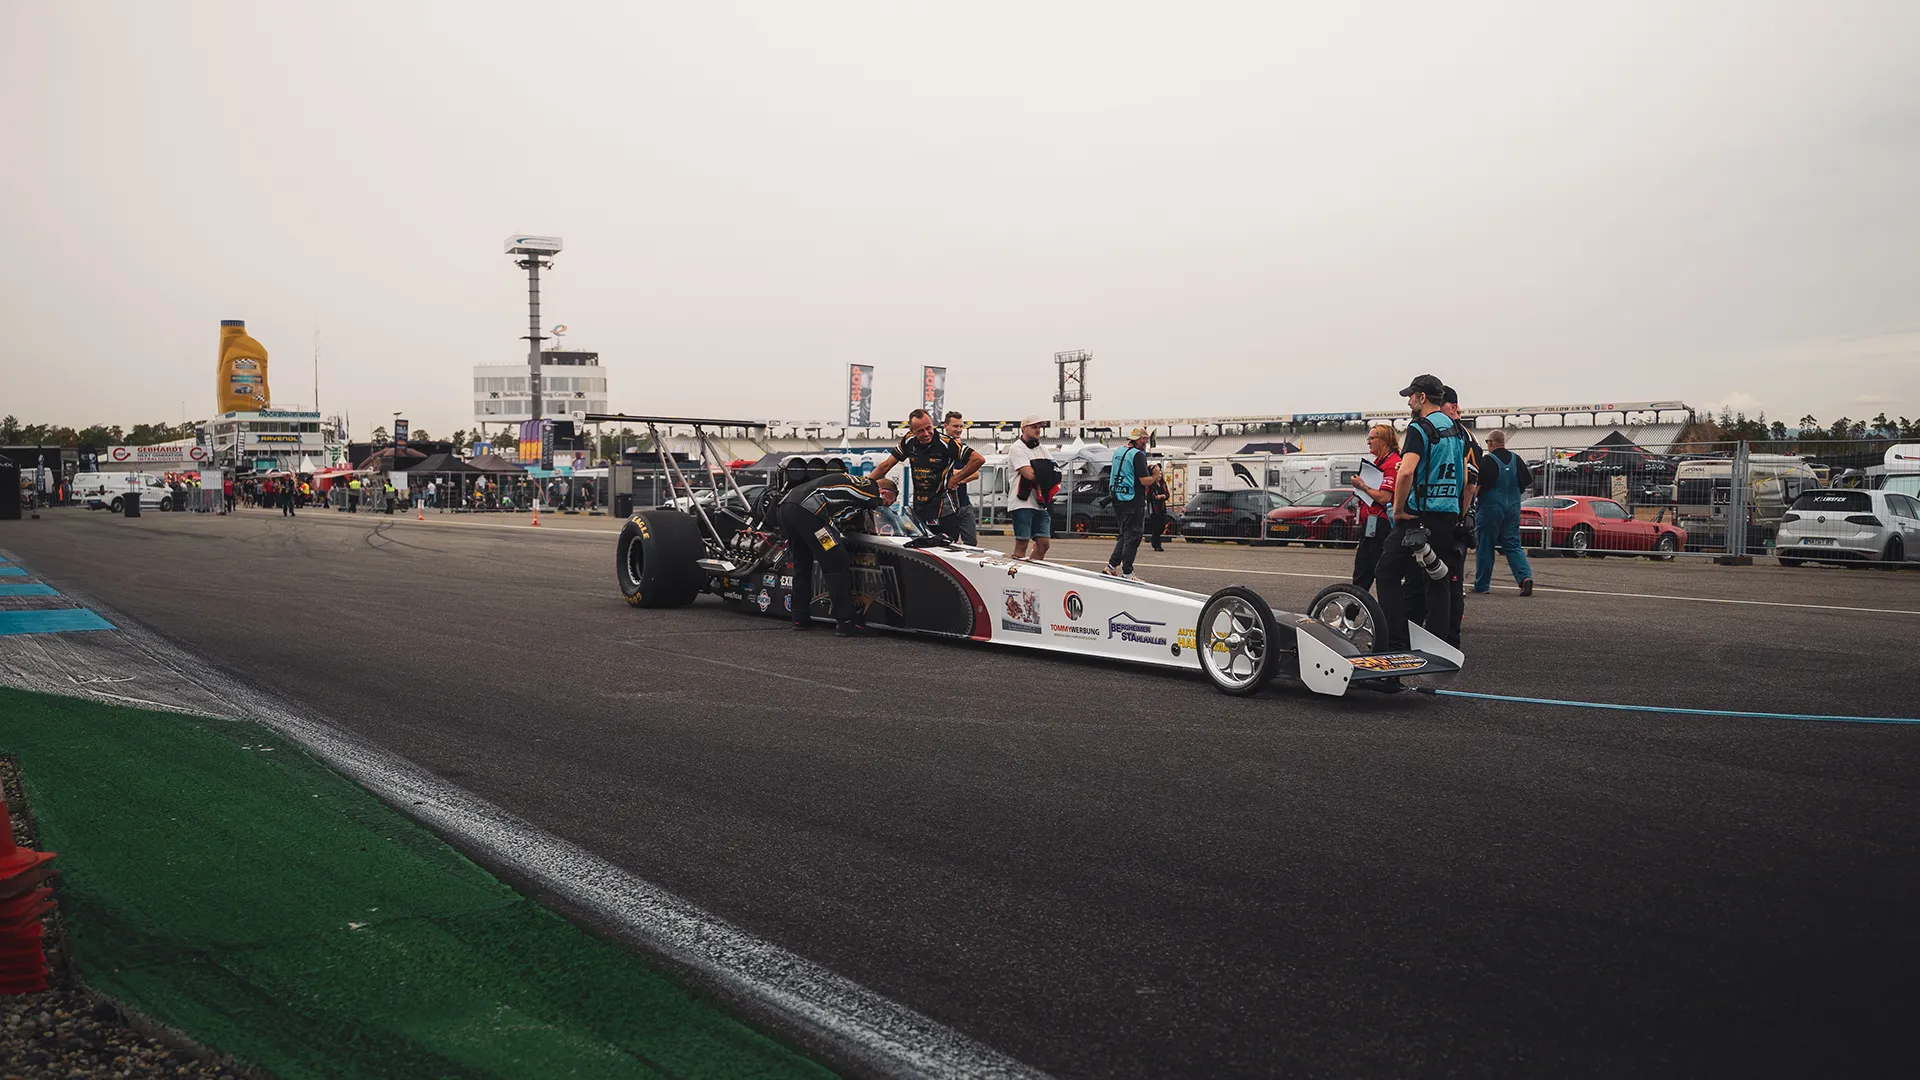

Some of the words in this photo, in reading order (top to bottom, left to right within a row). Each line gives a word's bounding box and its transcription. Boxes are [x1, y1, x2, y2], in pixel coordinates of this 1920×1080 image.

[851, 366, 862, 425] FANSHOP
[925, 368, 936, 419] ANSHOP
[1306, 413, 1347, 422] SACHS-KURVE
[1437, 463, 1456, 480] 18
[1427, 485, 1458, 496] MED
[631, 515, 650, 539] EAGLE
[1110, 623, 1152, 634] BERGHEIMER
[1121, 632, 1167, 646] STAHLHALLEN
